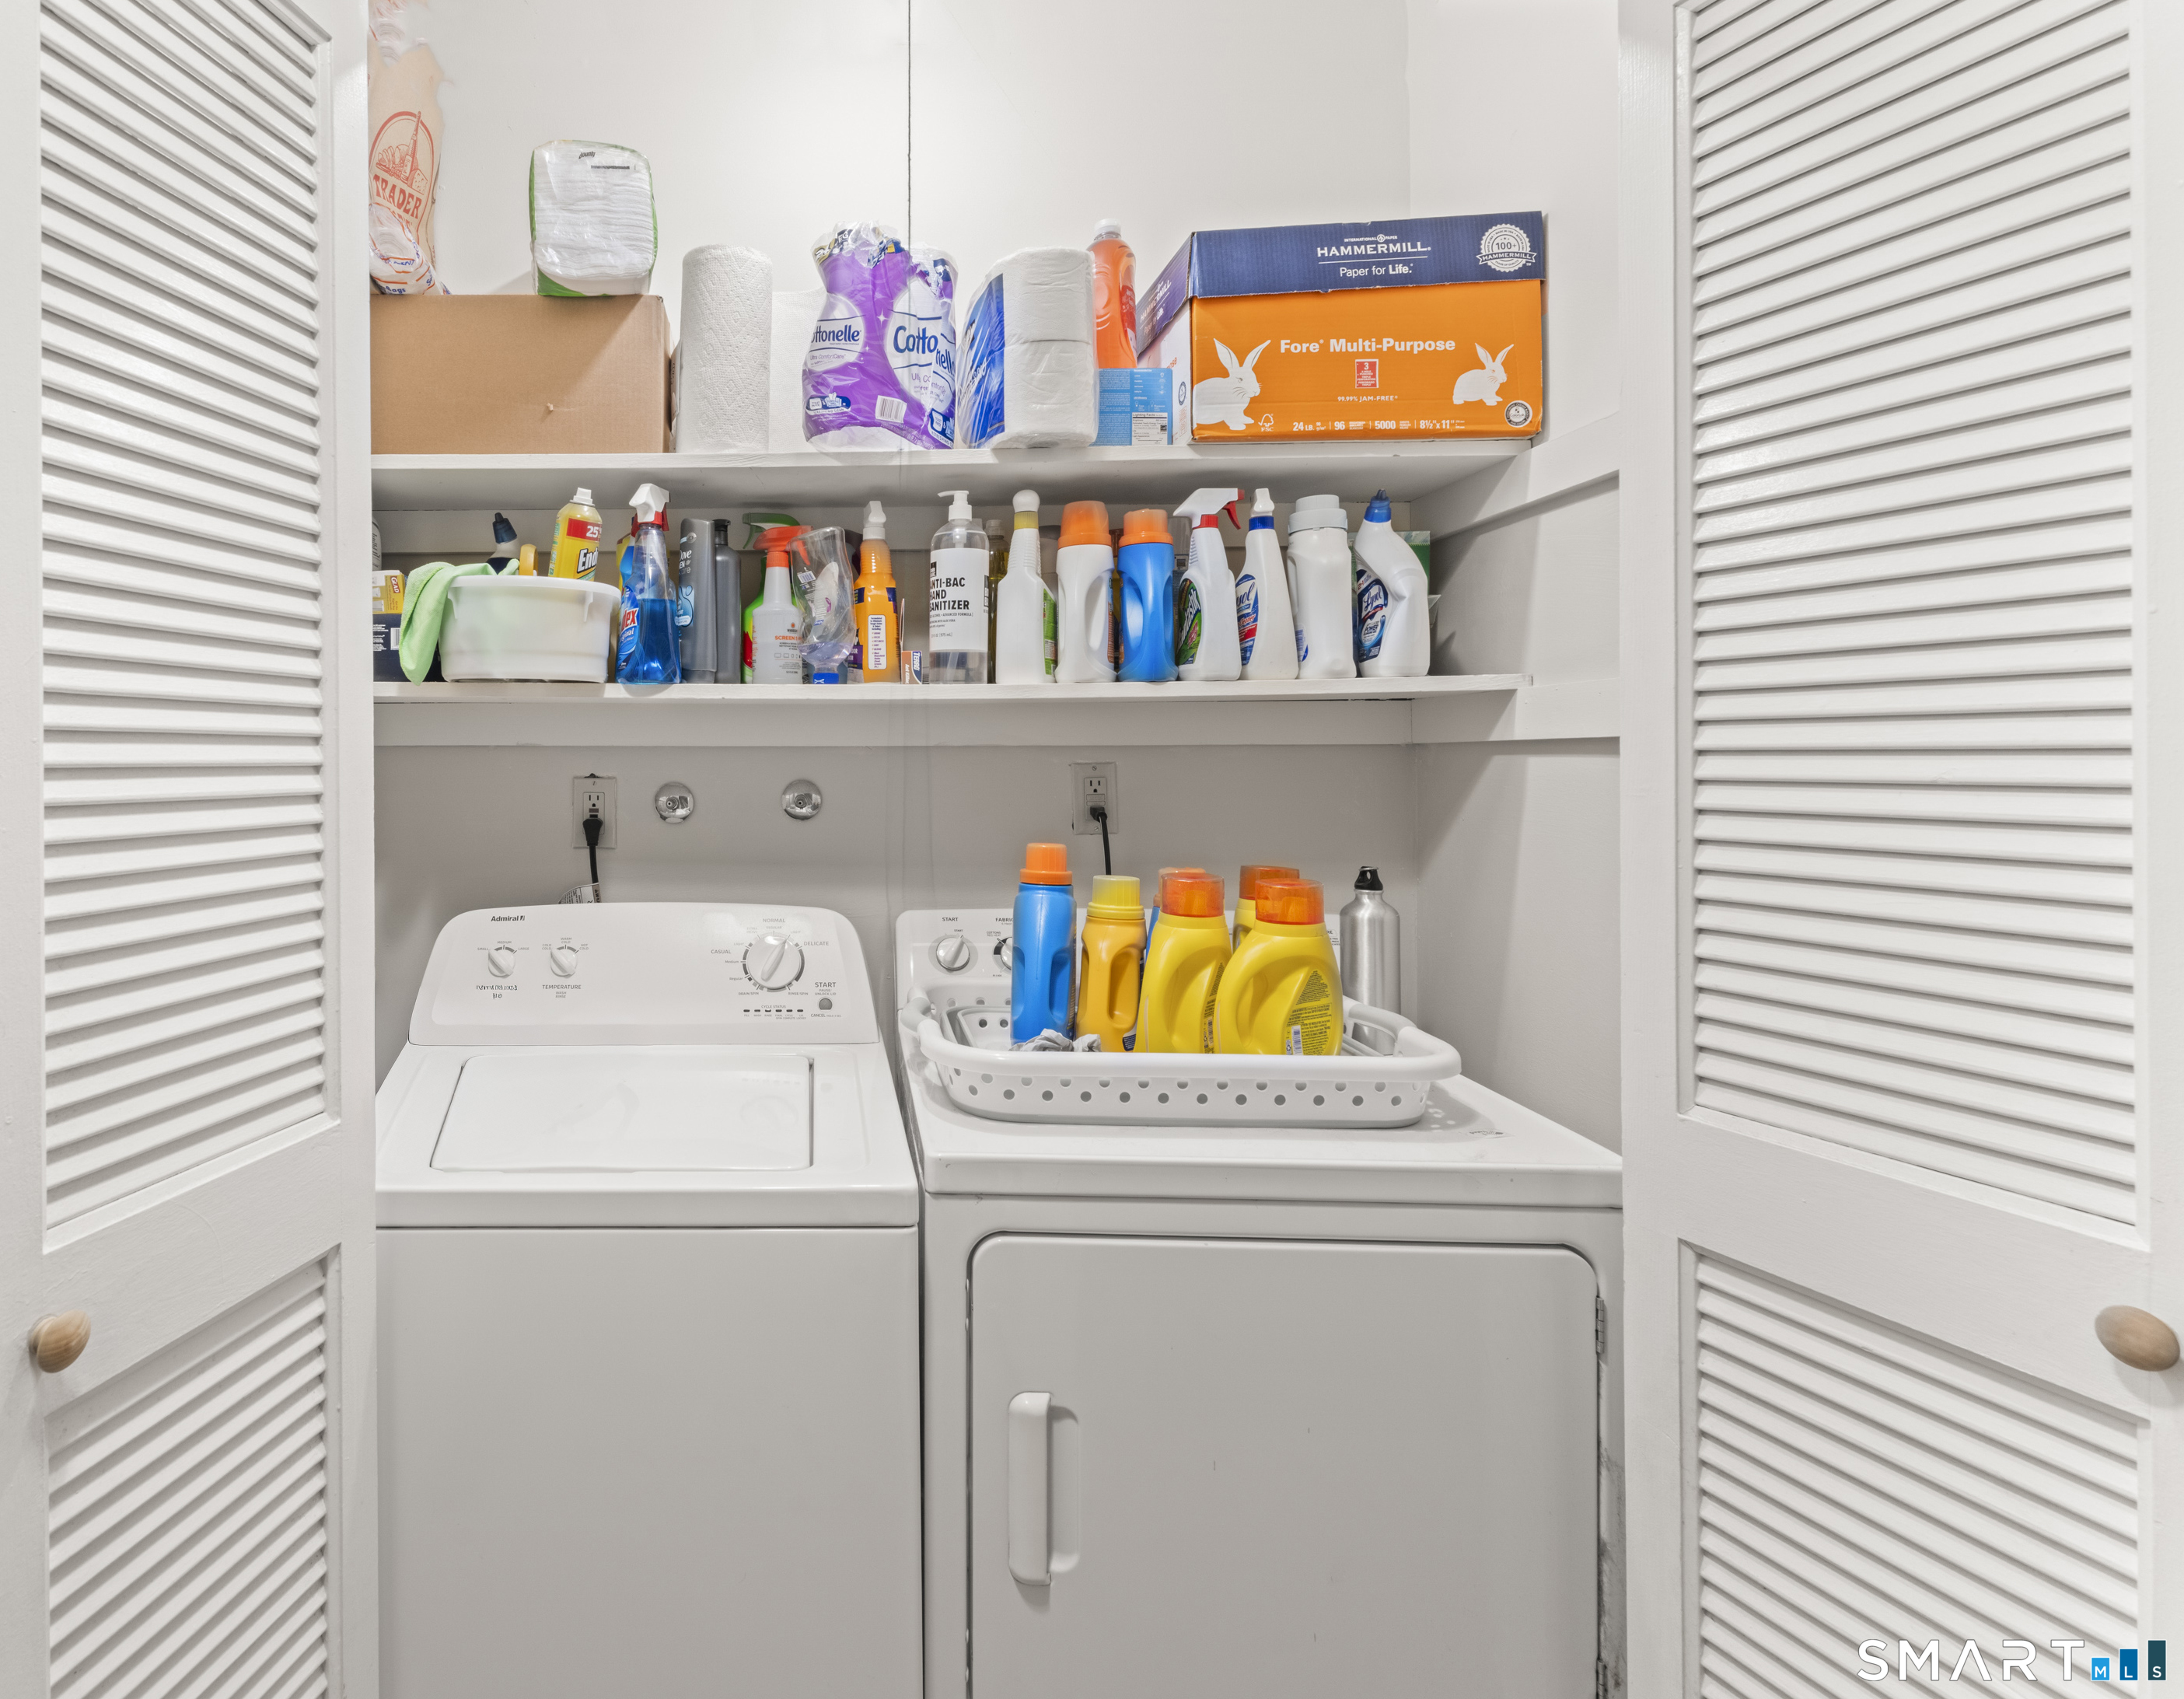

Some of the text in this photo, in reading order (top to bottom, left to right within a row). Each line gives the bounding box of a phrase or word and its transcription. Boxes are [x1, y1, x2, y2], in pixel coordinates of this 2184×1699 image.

[373, 173, 422, 219] TRADER
[1317, 241, 1427, 257] HAMMERMILL
[1496, 241, 1517, 250] 100+
[1482, 252, 1532, 261] HAMMERMILL
[1340, 267, 1369, 278] Paper
[1372, 265, 1386, 275] for
[1281, 337, 1455, 354] Fore Multi-Purpose
[1292, 422, 1304, 432] 24
[1333, 421, 1346, 430] 96
[1375, 420, 1396, 429] 5000
[390, 576, 400, 593] GLAD
[1364, 585, 1383, 612] Lysol
